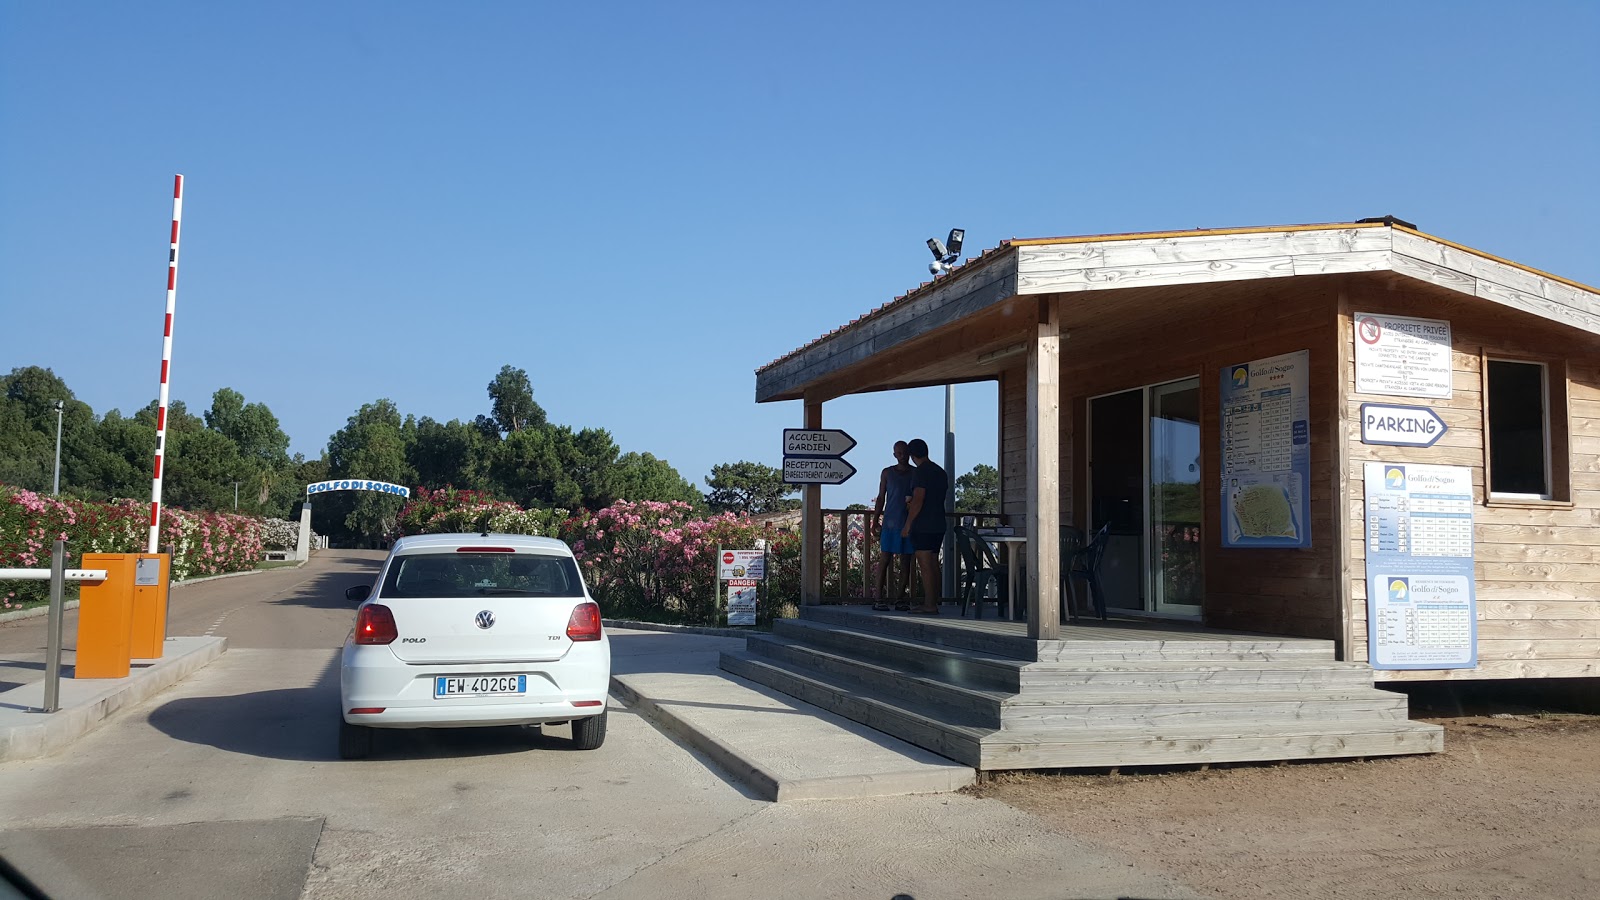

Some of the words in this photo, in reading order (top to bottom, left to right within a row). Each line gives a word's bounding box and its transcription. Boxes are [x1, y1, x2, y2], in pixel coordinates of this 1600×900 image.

[1367, 415, 1436, 434] PARKING
[789, 434, 828, 442] ACCUEIL
[788, 443, 830, 451] GARDIEN
[786, 461, 831, 469] RECEPTION
[308, 481, 350, 493] GOLFO
[351, 481, 363, 489] DI
[366, 482, 407, 497] SOGNO
[1439, 586, 1459, 594] Sogno
[448, 679, 465, 693] EW
[472, 678, 516, 692] 402GG
